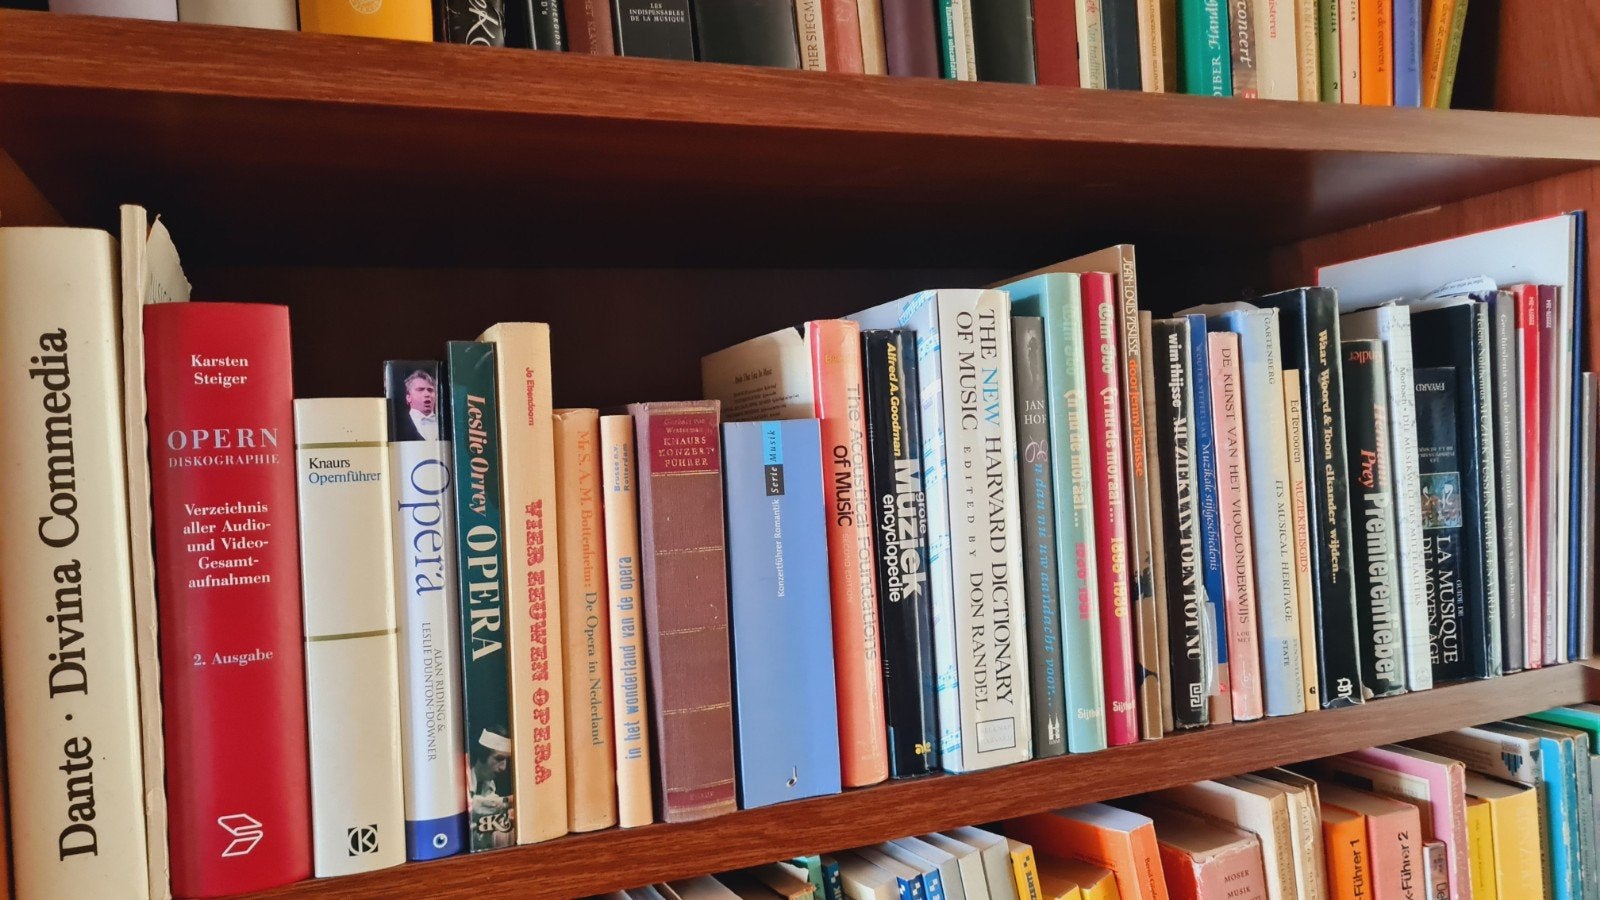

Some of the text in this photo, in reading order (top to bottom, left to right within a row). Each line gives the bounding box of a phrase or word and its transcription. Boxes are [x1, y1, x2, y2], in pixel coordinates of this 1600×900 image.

[1236, 1, 1252, 68] concert
[1333, 81, 1339, 90] 2
[978, 309, 997, 361] THE
[1169, 333, 1183, 363] wim
[1317, 329, 1330, 366] Waar
[190, 354, 249, 368] Karsten
[193, 372, 248, 388] Steiger
[526, 367, 534, 378] Jo
[956, 311, 979, 431] OF MUSIC
[1128, 359, 1139, 391] door
[886, 342, 902, 457] Alfred A. Goodman
[981, 367, 1000, 428] NEW
[1025, 400, 1045, 411] JAN
[1169, 364, 1184, 408] thijsse
[1320, 369, 1333, 413] Woord
[1399, 367, 1409, 405] Morbach
[167, 428, 279, 451] OPERN
[1324, 414, 1333, 426] &
[168, 454, 280, 468] DISKOGRAPHIE
[308, 457, 351, 469] Knaurs
[467, 394, 490, 517] Leslie Orrey
[769, 429, 780, 495] Serie Musik
[1133, 426, 1144, 478] Pisuisse
[1324, 427, 1335, 460] Toon
[308, 469, 382, 485] Opernführer
[833, 445, 852, 527] of Music
[1221, 348, 1250, 624] DE KUNST VAN HET VIOOLONDERWIJS
[1264, 316, 1294, 622] GARTENBERG ITS MUSICAL HERITAGE
[1290, 399, 1309, 573] Ed Tervooren MUZIEKREISGIDS
[1359, 449, 1377, 488] Prey
[1403, 436, 1415, 501] MUSIKWELT
[184, 501, 269, 516] Verzeichnis
[915, 491, 927, 534] grote
[963, 446, 977, 558] EDITED BY
[984, 436, 1007, 554] HARVARD
[1201, 441, 1220, 571] Muzikale stijlgeschiedenis
[1325, 464, 1339, 525] elkander
[183, 519, 271, 535] aller Audio-
[398, 458, 450, 596] Opera
[847, 384, 861, 421] The
[857, 535, 878, 661] Foundations
[894, 458, 926, 600] Muziek
[1037, 513, 1048, 538] nu
[186, 537, 269, 553] und Video-
[197, 555, 260, 571] Gesamt-
[772, 499, 786, 598] Konzertführer Romantik
[882, 494, 904, 603] encyclopedie
[1180, 536, 1196, 586] TOEN
[29, 328, 98, 862] Dante Divina Commedia
[188, 571, 271, 589] aufnahmen
[467, 525, 504, 662] OPERA
[585, 592, 597, 612] De
[1363, 492, 1398, 683] Premierenfieber
[1436, 535, 1459, 665] LA MUSIQUE
[1040, 567, 1058, 654] aandacht
[1184, 589, 1200, 629] TOT
[1457, 605, 1464, 617] DE
[525, 499, 553, 786] VIER EEUWEN OPERA
[585, 615, 599, 657] Opera
[970, 571, 989, 711] DON RANDEL
[992, 562, 1014, 706] DICTIONARY
[1186, 630, 1202, 660] NU
[1281, 639, 1290, 667] STATE
[193, 649, 274, 667] 2. Ausgabe
[588, 660, 600, 674] in
[618, 556, 642, 760] in het wonderland van de opera
[421, 622, 437, 763] LESLIE DUNTON-DOWNER
[433, 648, 446, 733] ALAN RIDING &
[589, 678, 604, 746] Nederland
[1349, 838, 1359, 848] 1
[1397, 830, 1408, 841] 2
[1223, 869, 1250, 883] MOSER
[1227, 886, 1251, 897] MUSIK
